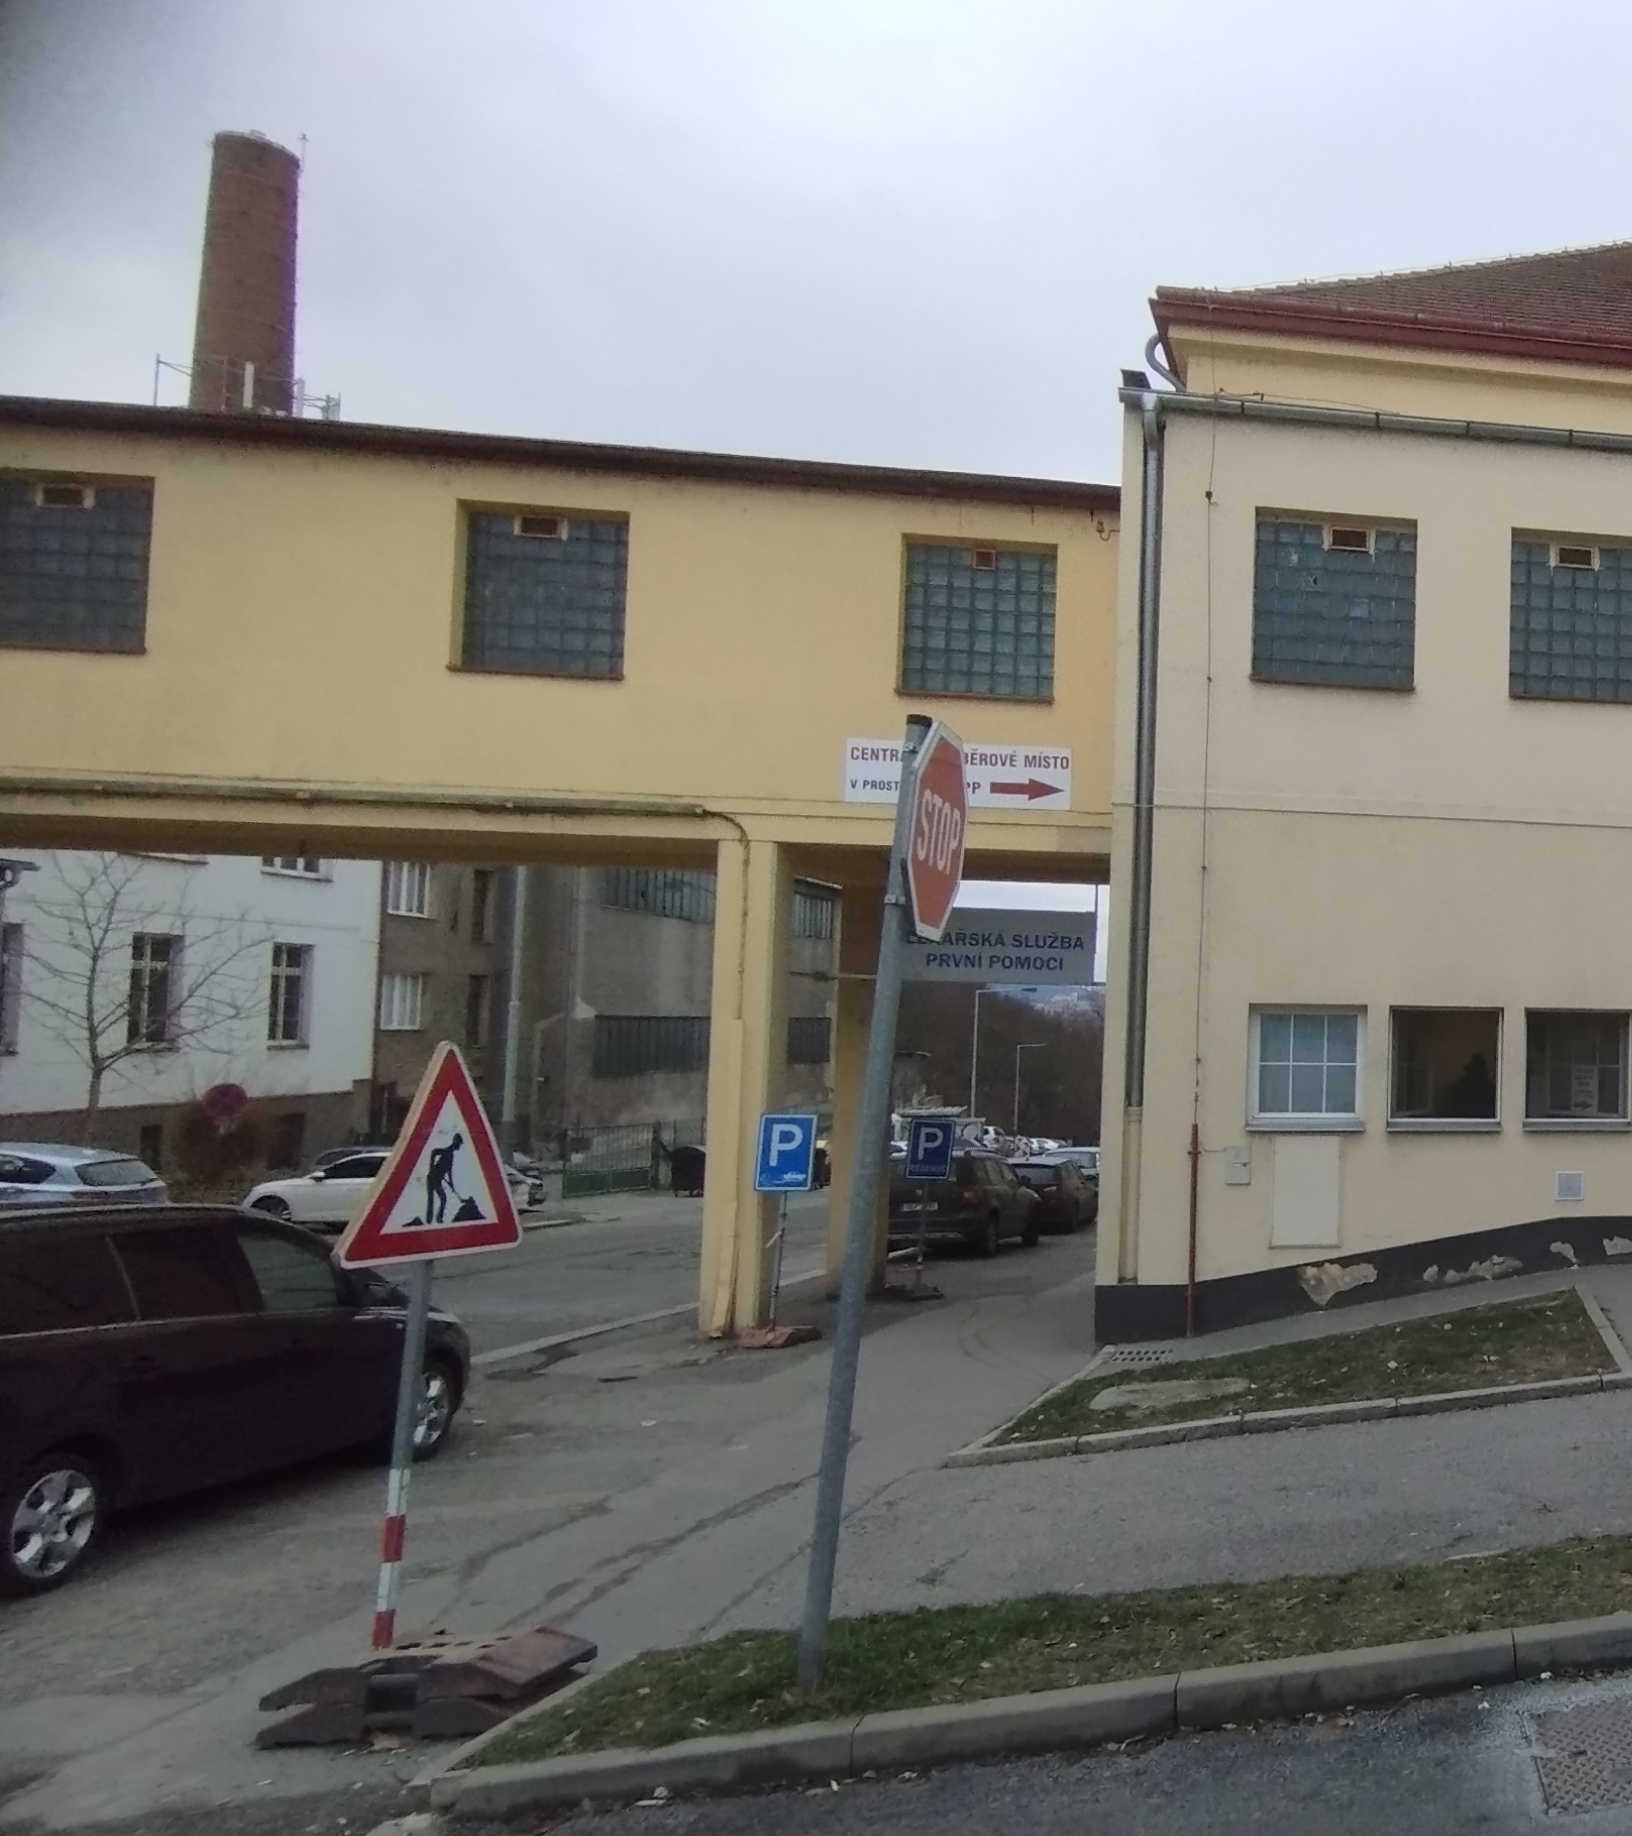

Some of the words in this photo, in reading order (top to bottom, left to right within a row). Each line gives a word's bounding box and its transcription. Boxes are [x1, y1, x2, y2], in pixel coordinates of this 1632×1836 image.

[850, 746, 903, 763] CENTR
[963, 748, 1017, 768] BĚROVÉ
[1024, 751, 1070, 770] MÍSTO
[850, 779, 858, 790] V
[862, 780, 901, 791] PROST
[917, 788, 961, 876] STOP
[906, 927, 1006, 947] LAŘSKÁ
[1011, 930, 1085, 950] SLUŽBA
[926, 951, 983, 968] PRVNÍ
[988, 955, 1064, 971] POMOCI
[769, 1123, 804, 1167] P
[917, 1127, 944, 1160] P
